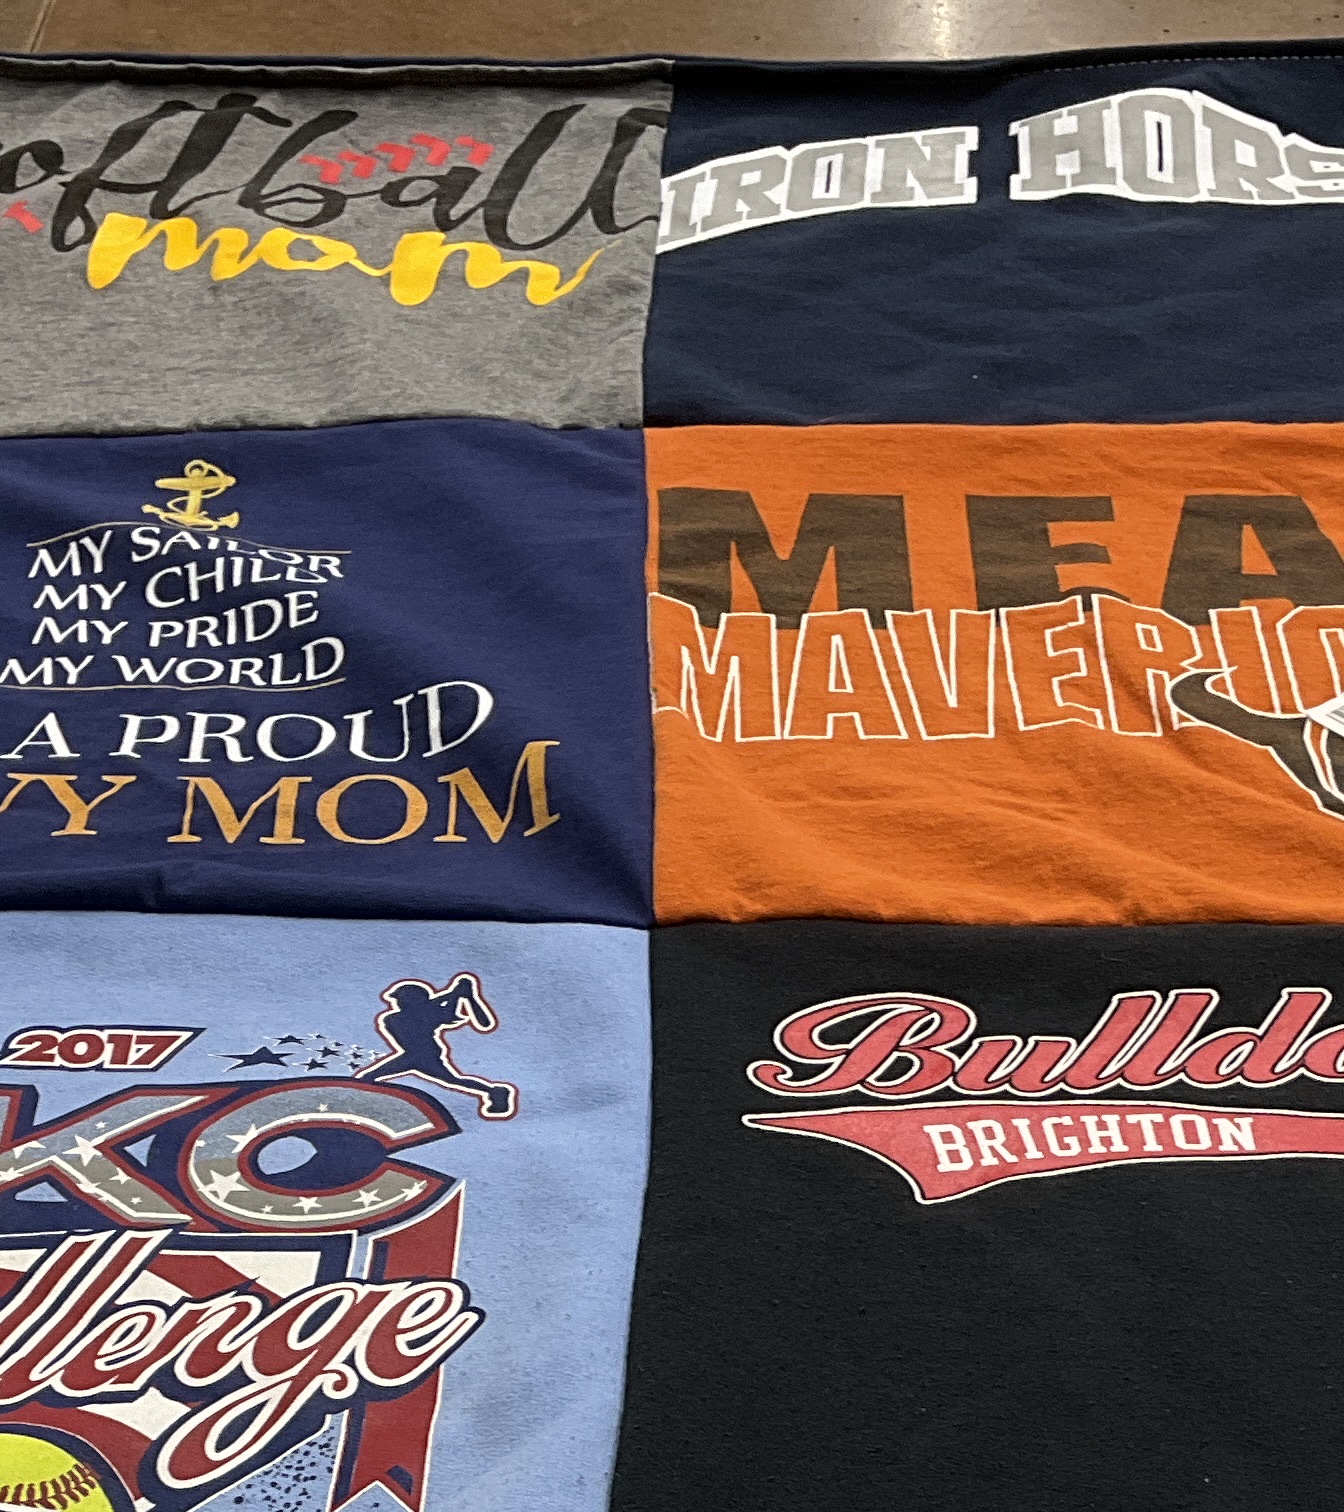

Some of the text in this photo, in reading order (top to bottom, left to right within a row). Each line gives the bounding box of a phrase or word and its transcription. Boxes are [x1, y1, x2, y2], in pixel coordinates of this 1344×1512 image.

[656, 126, 978, 253] IRON
[86, 212, 613, 306] mom
[27, 525, 345, 579] MY SAILOR
[31, 590, 320, 649] MY PRIDE
[32, 580, 128, 611] MY
[111, 636, 346, 686] WORLD
[109, 680, 494, 765] PROUD
[167, 738, 561, 845] MOM
[1, 1030, 188, 1067] 2017
[923, 1114, 1257, 1173] BRIGHTON
